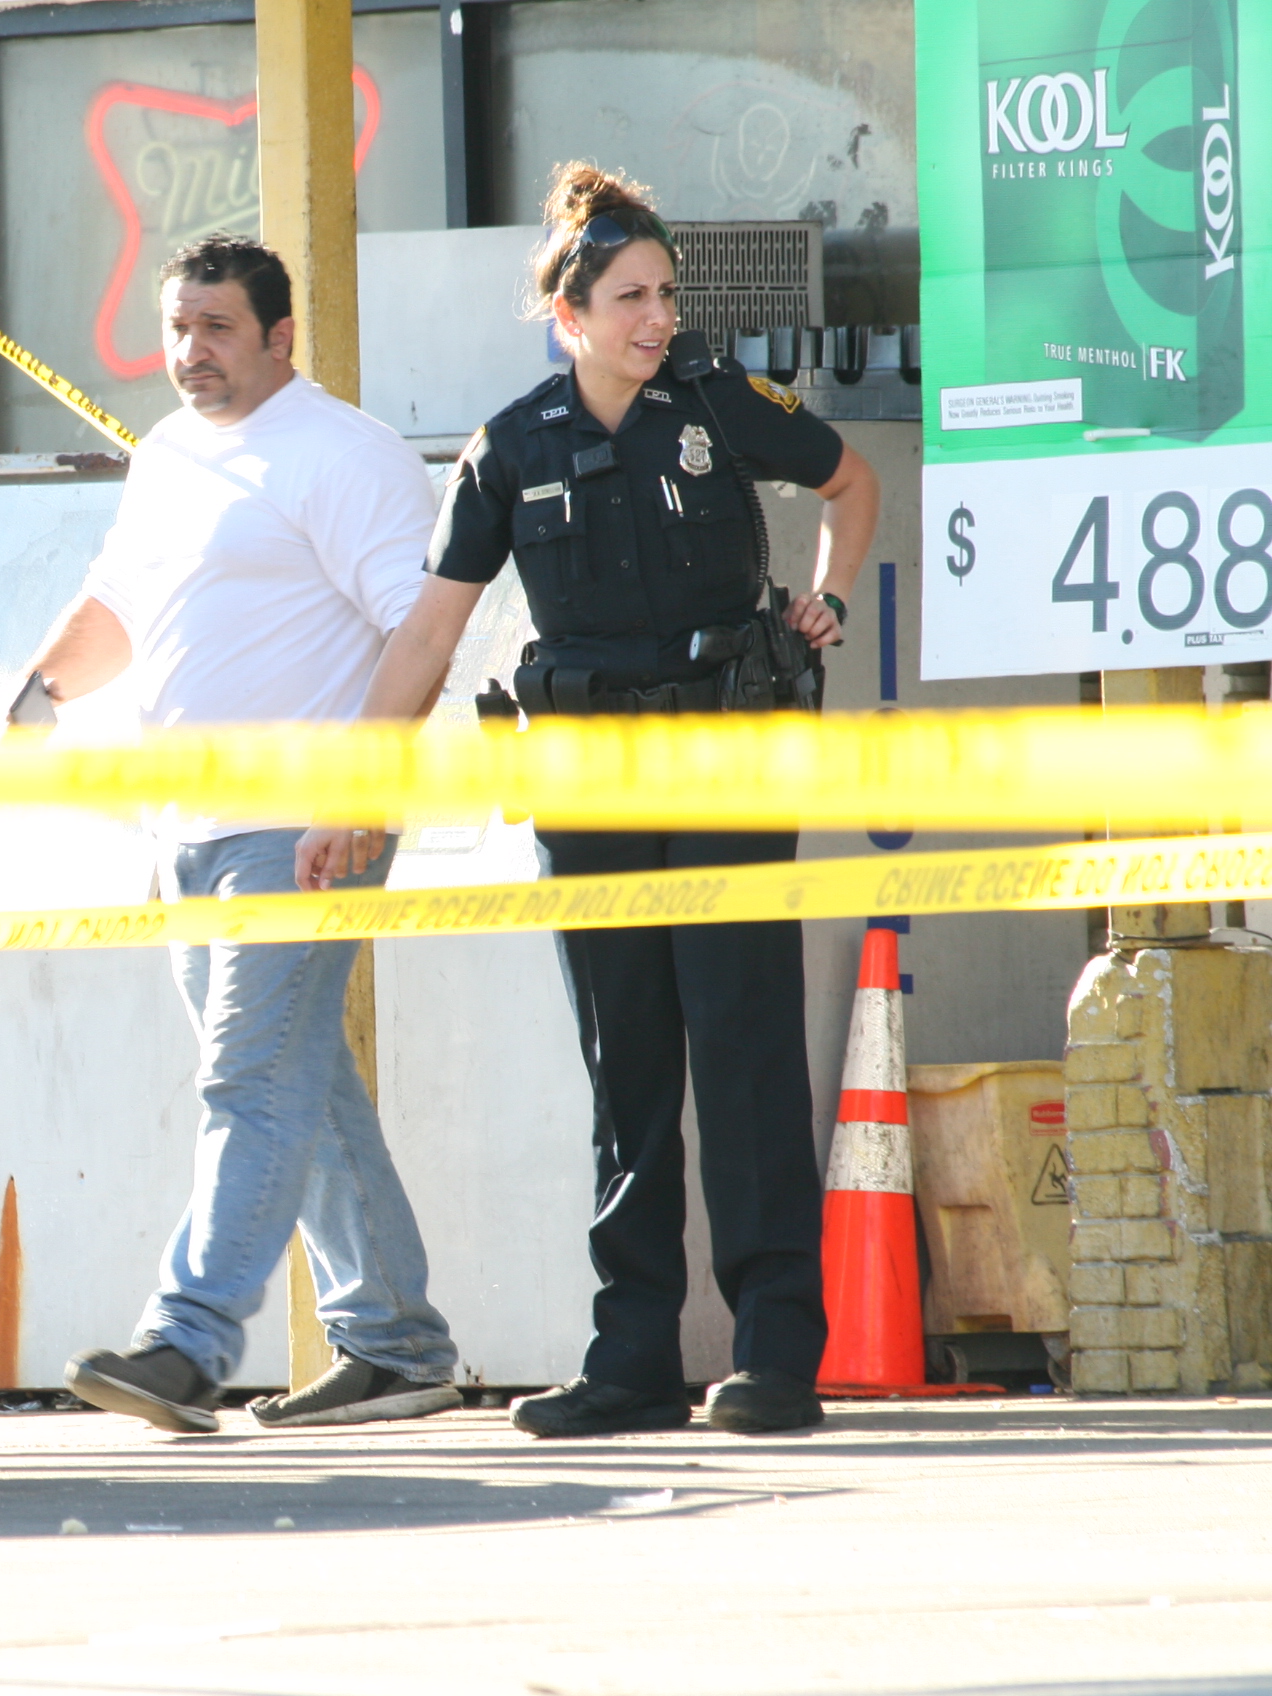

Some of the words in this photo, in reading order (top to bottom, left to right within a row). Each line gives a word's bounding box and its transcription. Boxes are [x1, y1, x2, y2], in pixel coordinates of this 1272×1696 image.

[986, 67, 1130, 154] KOOL
[992, 161, 1048, 179] FILTER
[1057, 158, 1115, 178] KINGS
[1202, 83, 1235, 281] KOOL
[1044, 343, 1072, 362] TRUE
[1079, 346, 1137, 369] MENTHOL
[1149, 346, 1187, 382] FK
[946, 501, 976, 587] $
[1051, 488, 1272, 645] 4.88
[1187, 635, 1207, 645] PLUS
